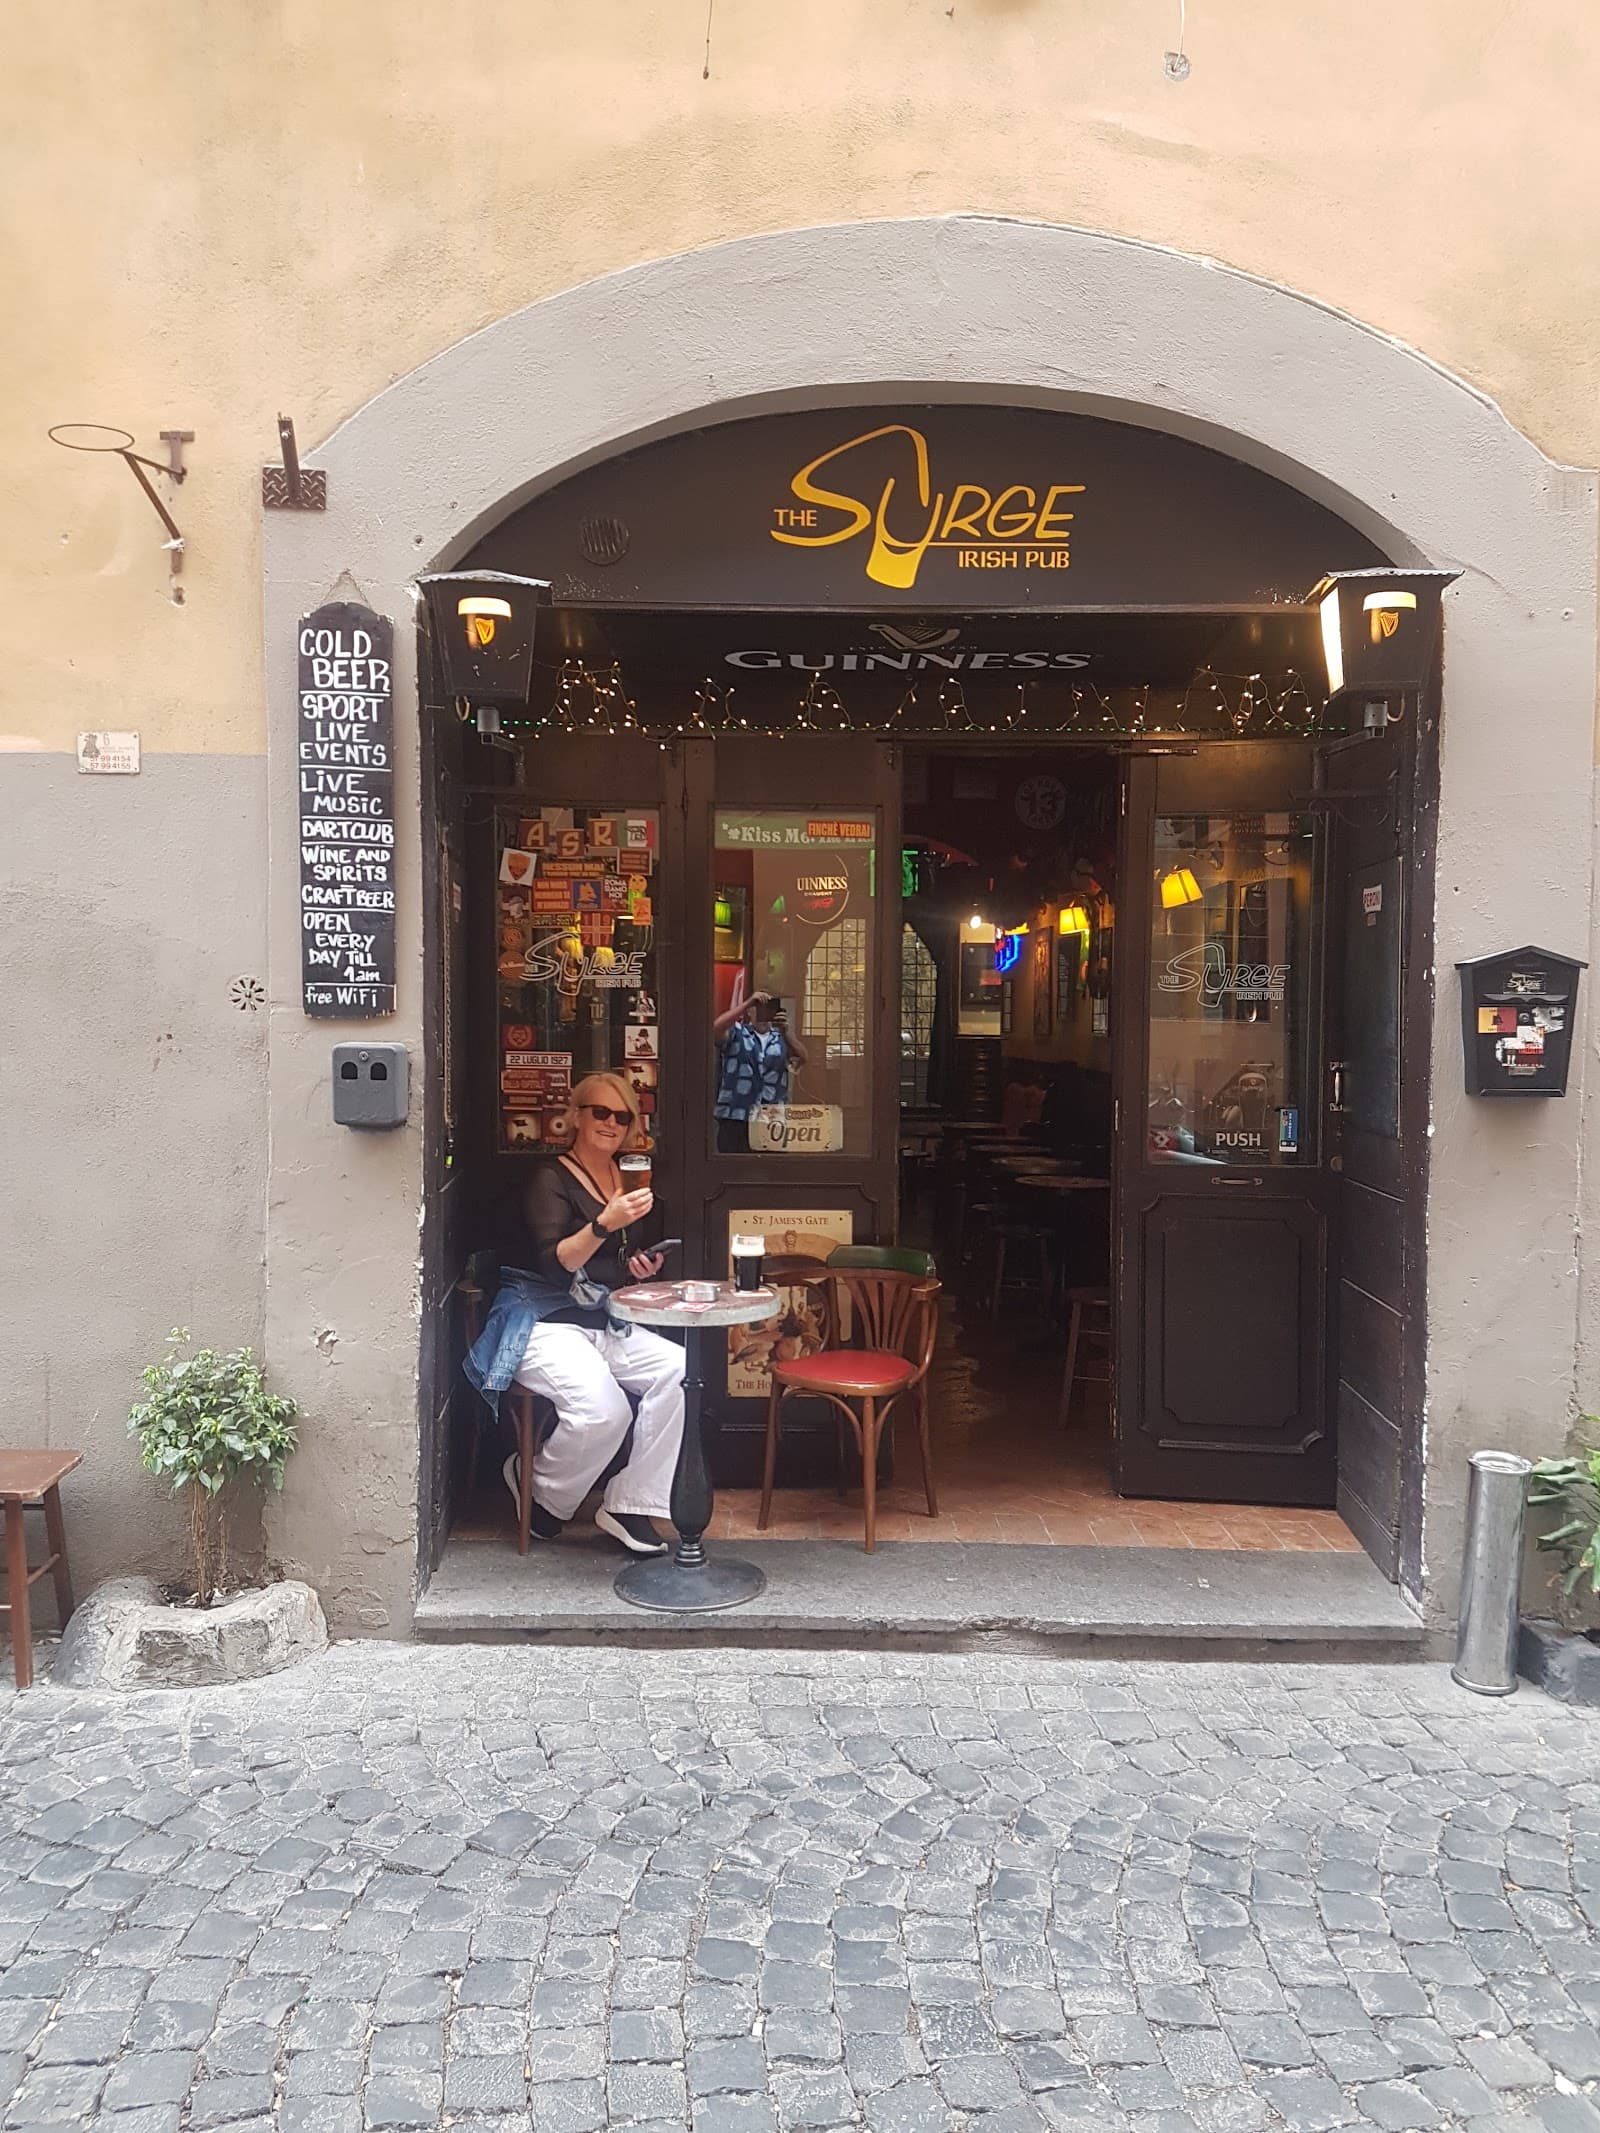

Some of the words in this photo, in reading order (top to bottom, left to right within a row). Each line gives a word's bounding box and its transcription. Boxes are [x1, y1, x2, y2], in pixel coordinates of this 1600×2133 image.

[771, 424, 1086, 589] SURGE
[774, 510, 817, 527] THE
[958, 550, 1018, 568] IRISH
[1025, 551, 1070, 569] PUB
[300, 628, 372, 658] COLD
[724, 650, 1092, 671] GUINNESS
[312, 657, 391, 692] BEER
[302, 694, 384, 722] SPORT
[315, 721, 370, 743] LIVE
[300, 742, 387, 766] EVENTS
[741, 825, 781, 843] Kiss
[355, 848, 391, 863] AND
[303, 912, 352, 933] OPEN
[315, 933, 375, 952] EVERY
[309, 948, 341, 968] DAY
[344, 966, 381, 982] 1am
[1157, 942, 1291, 1008] SURGE
[305, 986, 333, 1004] free
[510, 1055, 520, 1064] 22
[522, 1056, 549, 1065] LUGLIO
[550, 1056, 569, 1065] 1927
[767, 1120, 823, 1148] Open
[1215, 1132, 1261, 1147] PUSH
